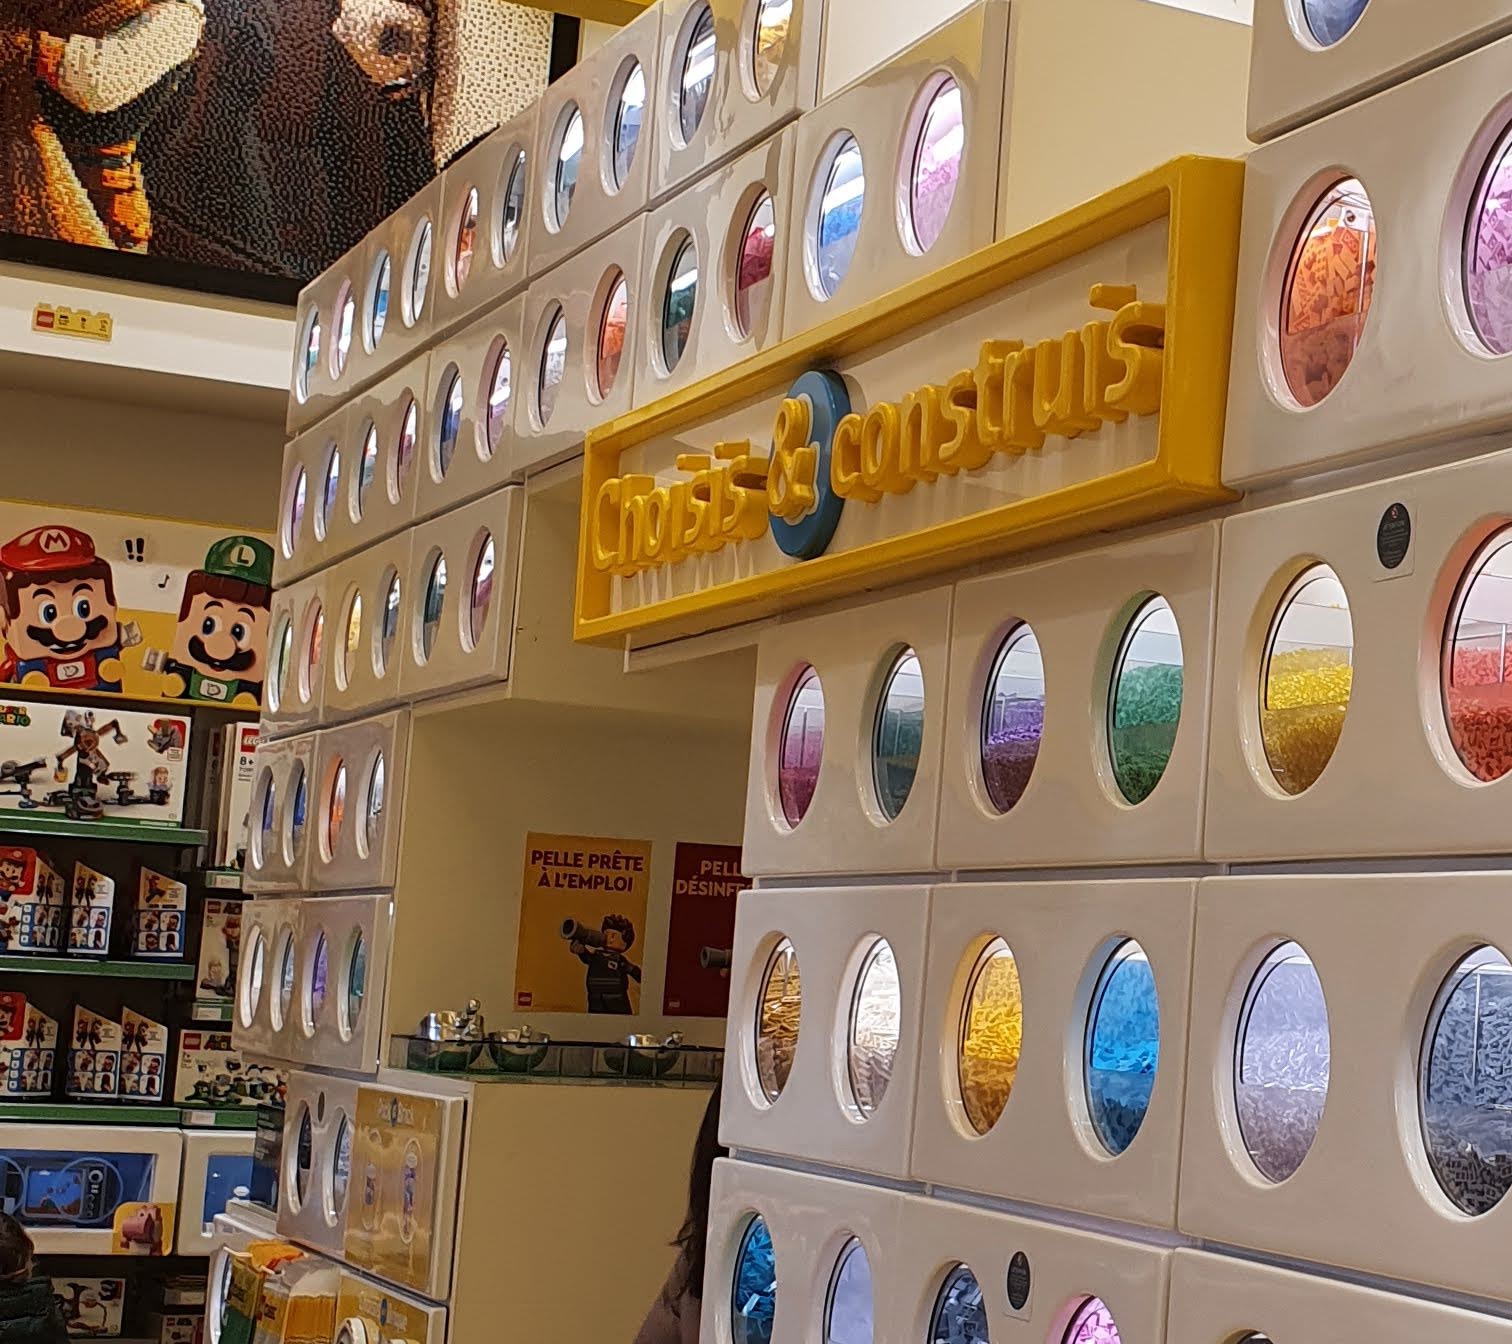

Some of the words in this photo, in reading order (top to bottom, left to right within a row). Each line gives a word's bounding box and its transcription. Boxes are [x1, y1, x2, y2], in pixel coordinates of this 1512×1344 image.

[767, 398, 818, 518] &
[830, 283, 1166, 504] construis
[44, 532, 67, 552] M
[237, 547, 249, 564] L
[531, 849, 583, 868] PELLE
[588, 849, 644, 872] PRÊTE
[700, 859, 742, 876] PELL
[538, 866, 551, 888] À
[554, 873, 634, 893] L'EMPLOI
[675, 872, 753, 897] DÉSINF
